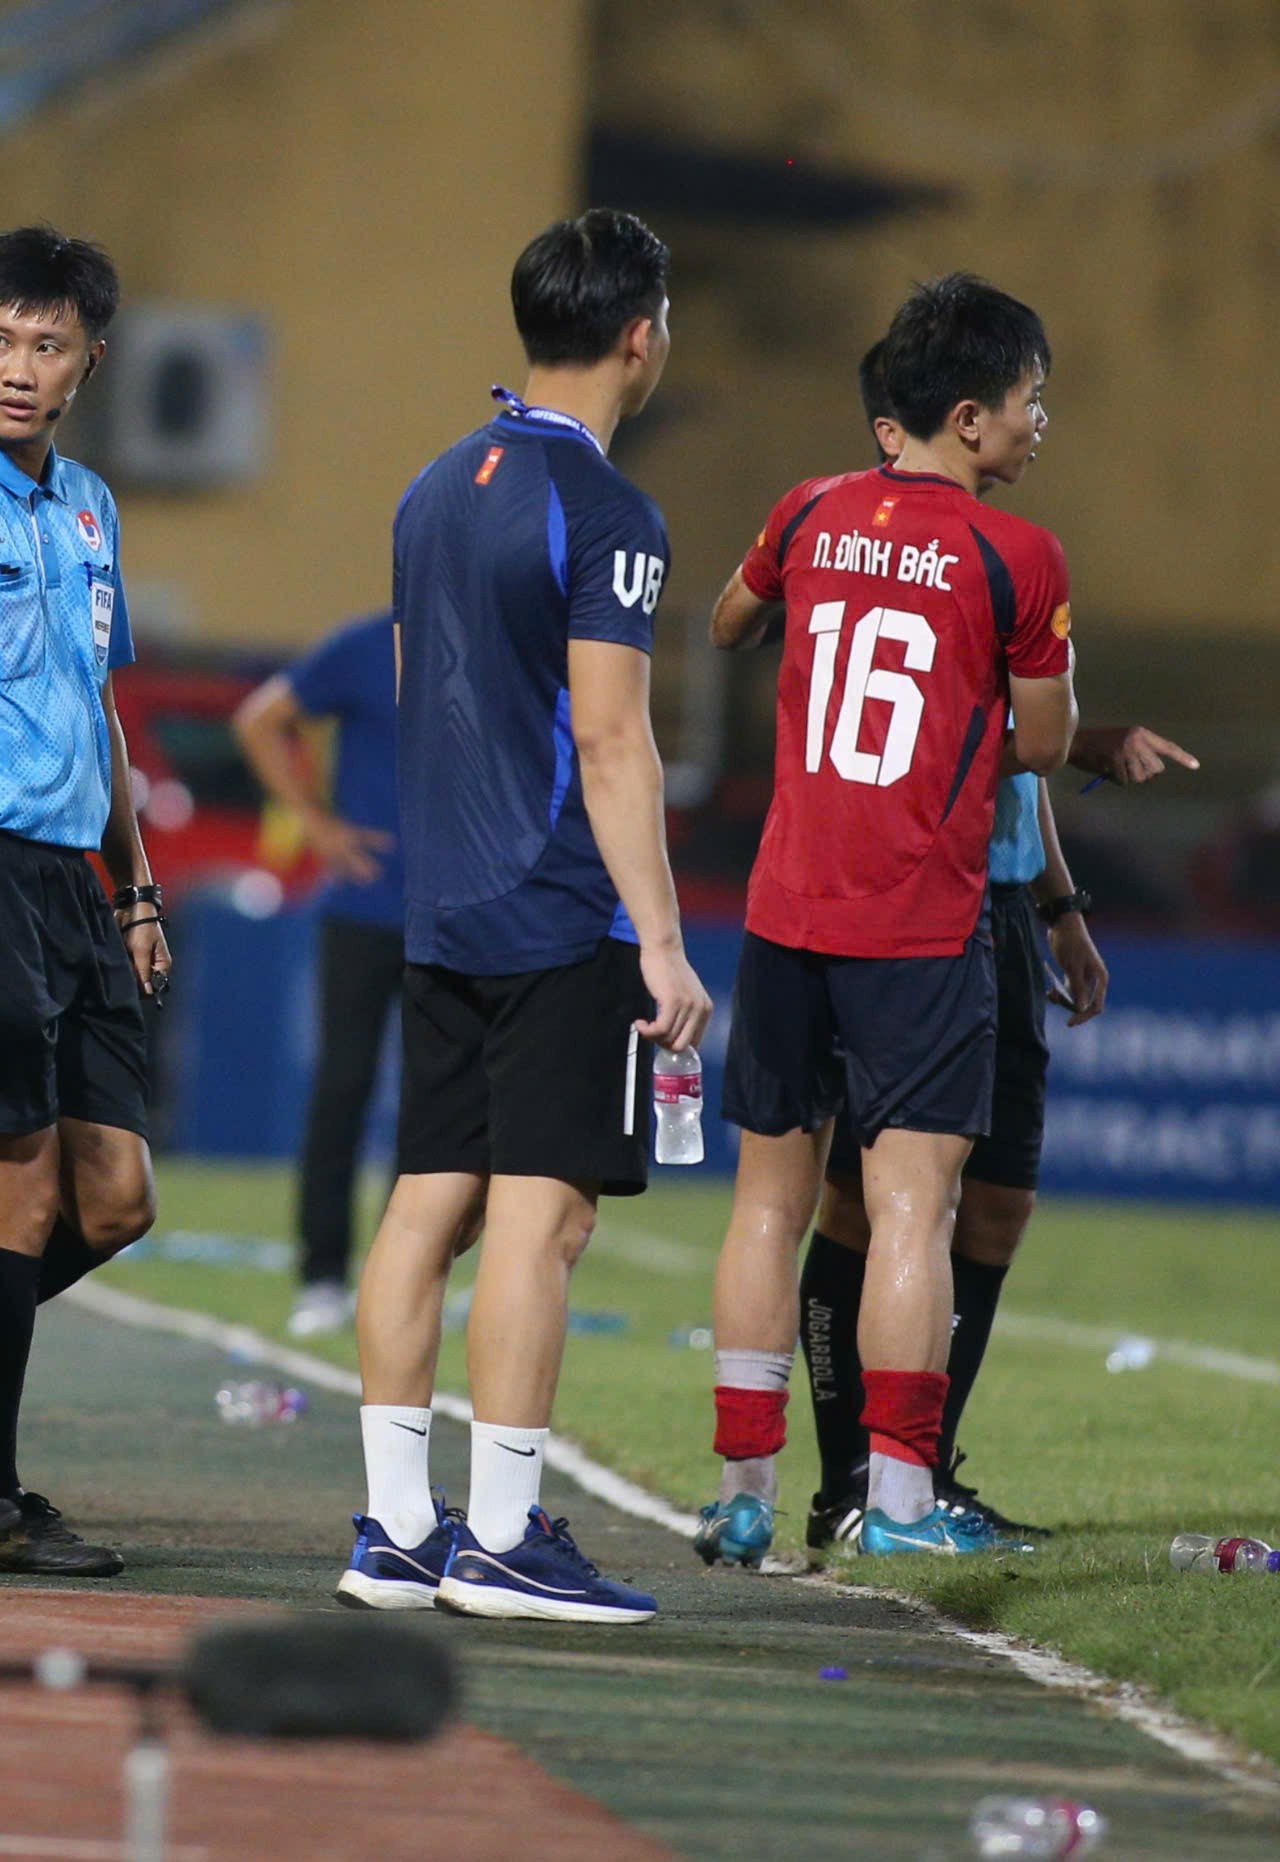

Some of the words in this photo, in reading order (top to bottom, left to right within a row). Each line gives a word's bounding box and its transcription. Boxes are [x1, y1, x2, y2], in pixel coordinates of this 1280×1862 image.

[612, 550, 665, 615] VB
[812, 529, 892, 577] N.ĐÌNH
[897, 538, 959, 591] BẮC
[95, 589, 112, 611] FIFA
[805, 600, 937, 788] 16
[808, 1297, 837, 1401] JOGARBOLA
